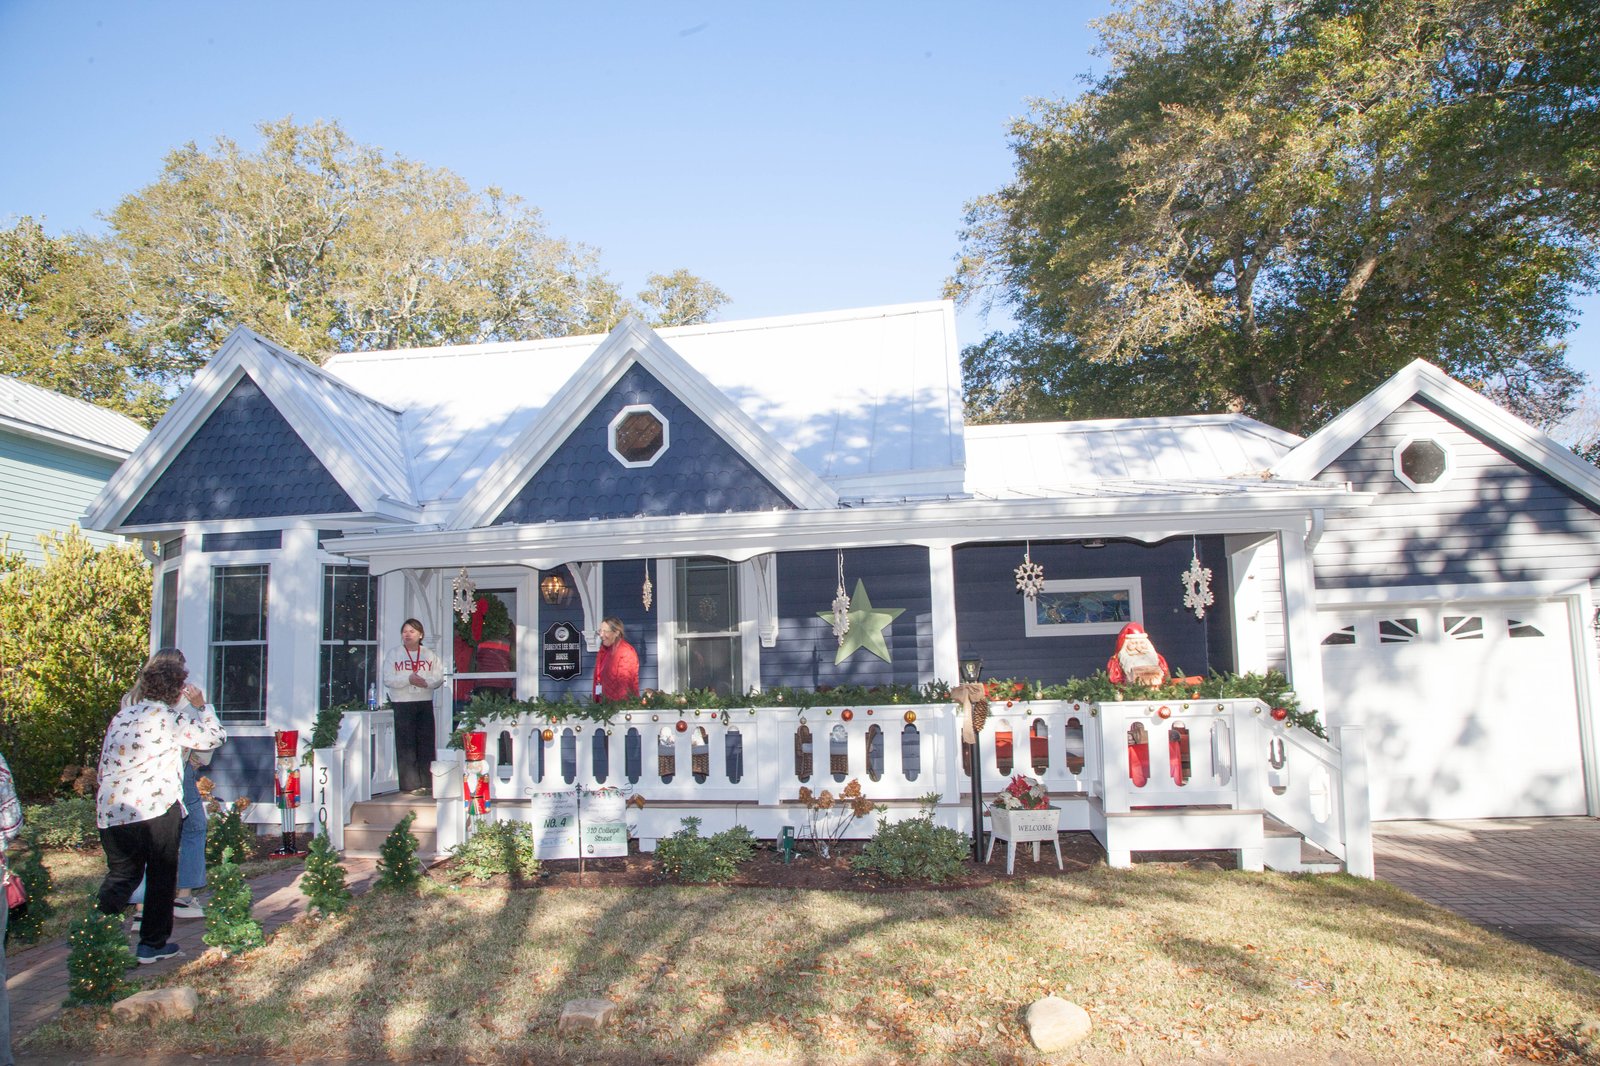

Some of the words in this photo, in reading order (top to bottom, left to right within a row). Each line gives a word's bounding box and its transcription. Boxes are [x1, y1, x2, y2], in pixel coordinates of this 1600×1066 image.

[318, 766, 328, 823] 310
[560, 817, 567, 828] 4
[586, 826, 597, 834] 310
[598, 826, 620, 835] College
[1017, 824, 1053, 832] WELCOME
[594, 834, 613, 842] Street
